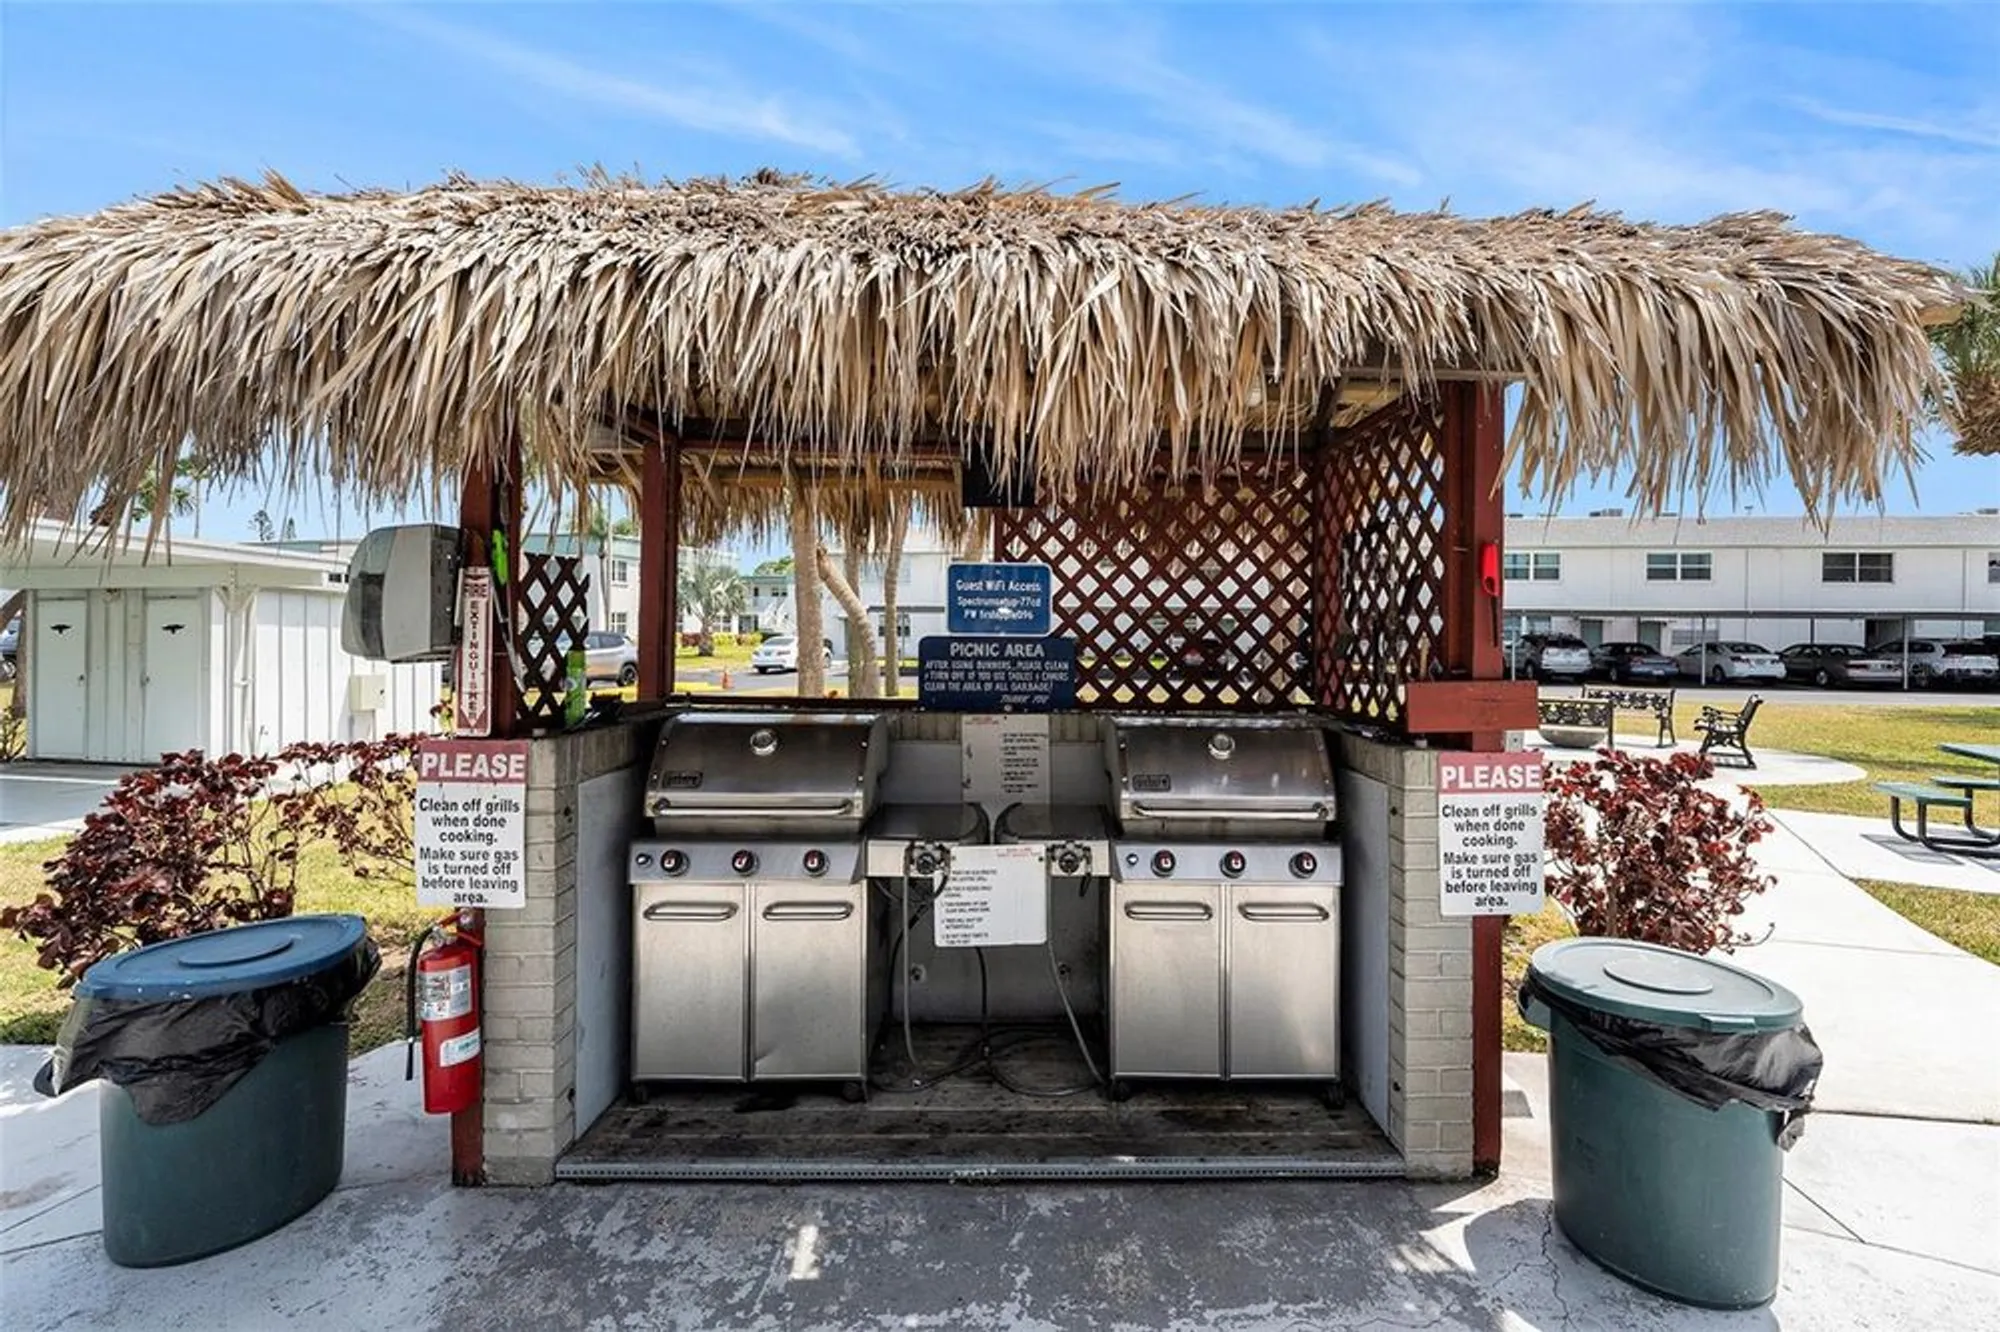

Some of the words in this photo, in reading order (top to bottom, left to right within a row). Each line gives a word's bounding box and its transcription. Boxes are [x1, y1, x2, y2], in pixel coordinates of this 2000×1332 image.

[956, 580, 983, 591] Guest
[985, 580, 1005, 591] WiFi
[950, 642, 1000, 657] PICNIC
[1004, 643, 1045, 657] AREA
[1044, 660, 1070, 670] CLEAN
[421, 752, 526, 778] PLEASE
[1441, 765, 1541, 789] PLEASE
[419, 798, 458, 812] Clean
[462, 798, 481, 812] off
[486, 799, 520, 815] grills
[1442, 804, 1479, 818] Clean
[1483, 804, 1500, 818] off
[1504, 804, 1537, 820] grills
[432, 815, 469, 828] when
[473, 815, 507, 828] done
[1454, 820, 1489, 832] when
[1493, 820, 1525, 832] done
[439, 829, 497, 846] cooking.
[1462, 834, 1518, 849] cooking.
[420, 847, 456, 861] Make
[460, 850, 490, 861] sure
[494, 851, 519, 864] gas
[1444, 852, 1478, 865] Make
[1482, 854, 1511, 865] sure
[1514, 854, 1537, 867] gas
[427, 863, 439, 875] is
[444, 863, 488, 875] turned
[492, 863, 511, 875] off
[1451, 867, 1462, 879] is
[1466, 866, 1509, 878] turned
[1512, 865, 1531, 877] off
[422, 876, 465, 889] before
[470, 877, 518, 892] leaving
[1446, 881, 1487, 893] before
[1490, 880, 1537, 895] leaving
[454, 893, 488, 903] area.
[1474, 896, 1508, 907] area.
